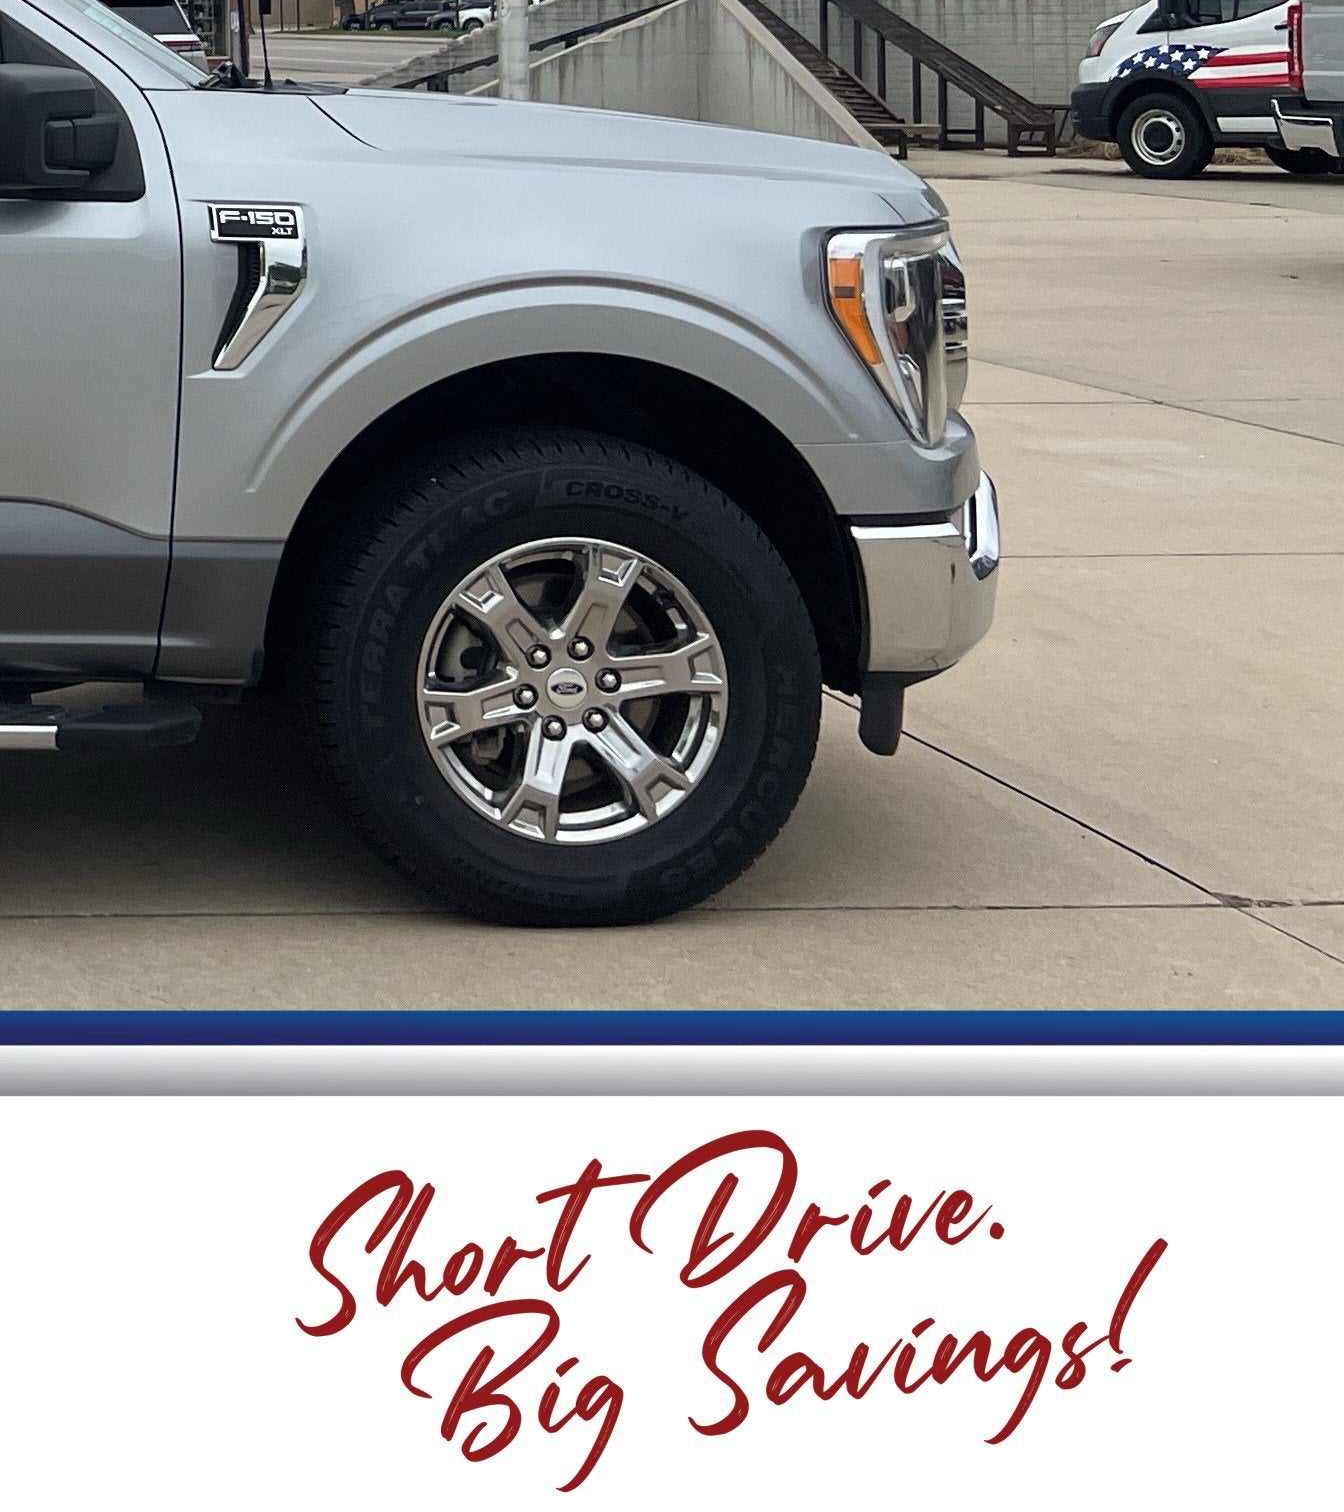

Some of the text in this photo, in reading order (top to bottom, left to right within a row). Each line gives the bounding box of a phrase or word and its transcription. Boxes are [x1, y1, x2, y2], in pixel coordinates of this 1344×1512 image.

[218, 210, 295, 226] F-150
[271, 226, 293, 236] XLT
[564, 479, 690, 524] CROSS-V
